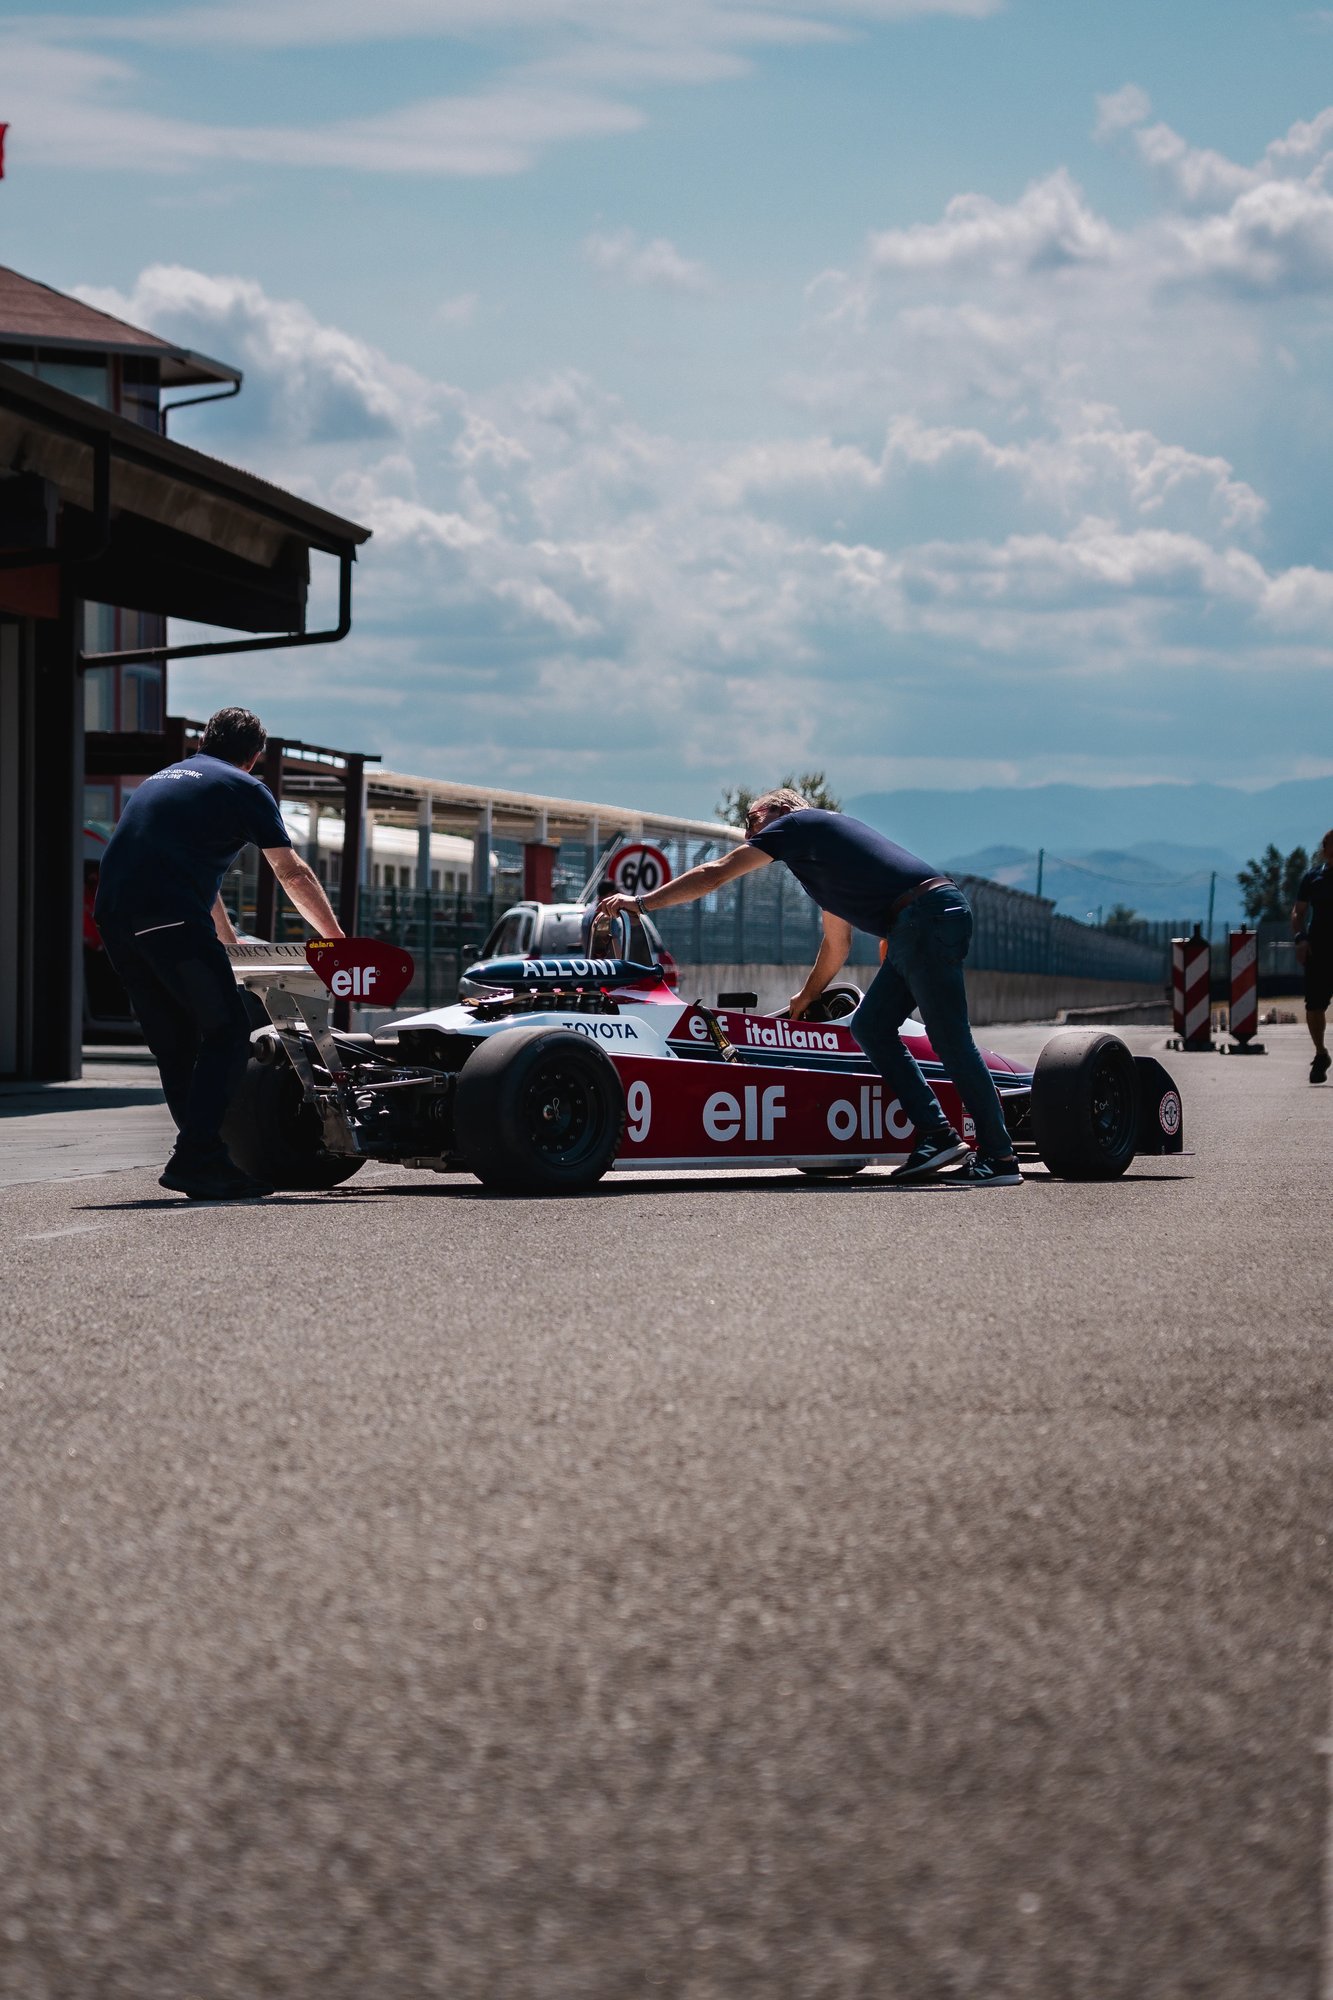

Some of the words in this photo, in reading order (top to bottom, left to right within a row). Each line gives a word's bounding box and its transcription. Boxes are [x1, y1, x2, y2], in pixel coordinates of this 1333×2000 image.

[621, 860, 659, 891] 60
[331, 966, 377, 997] elf
[562, 1022, 639, 1039] TOYOTA
[688, 1014, 730, 1042] ef
[744, 1018, 840, 1050] italiana
[626, 1080, 652, 1143] 9
[702, 1085, 787, 1142] elf
[964, 1122, 976, 1132] CH
